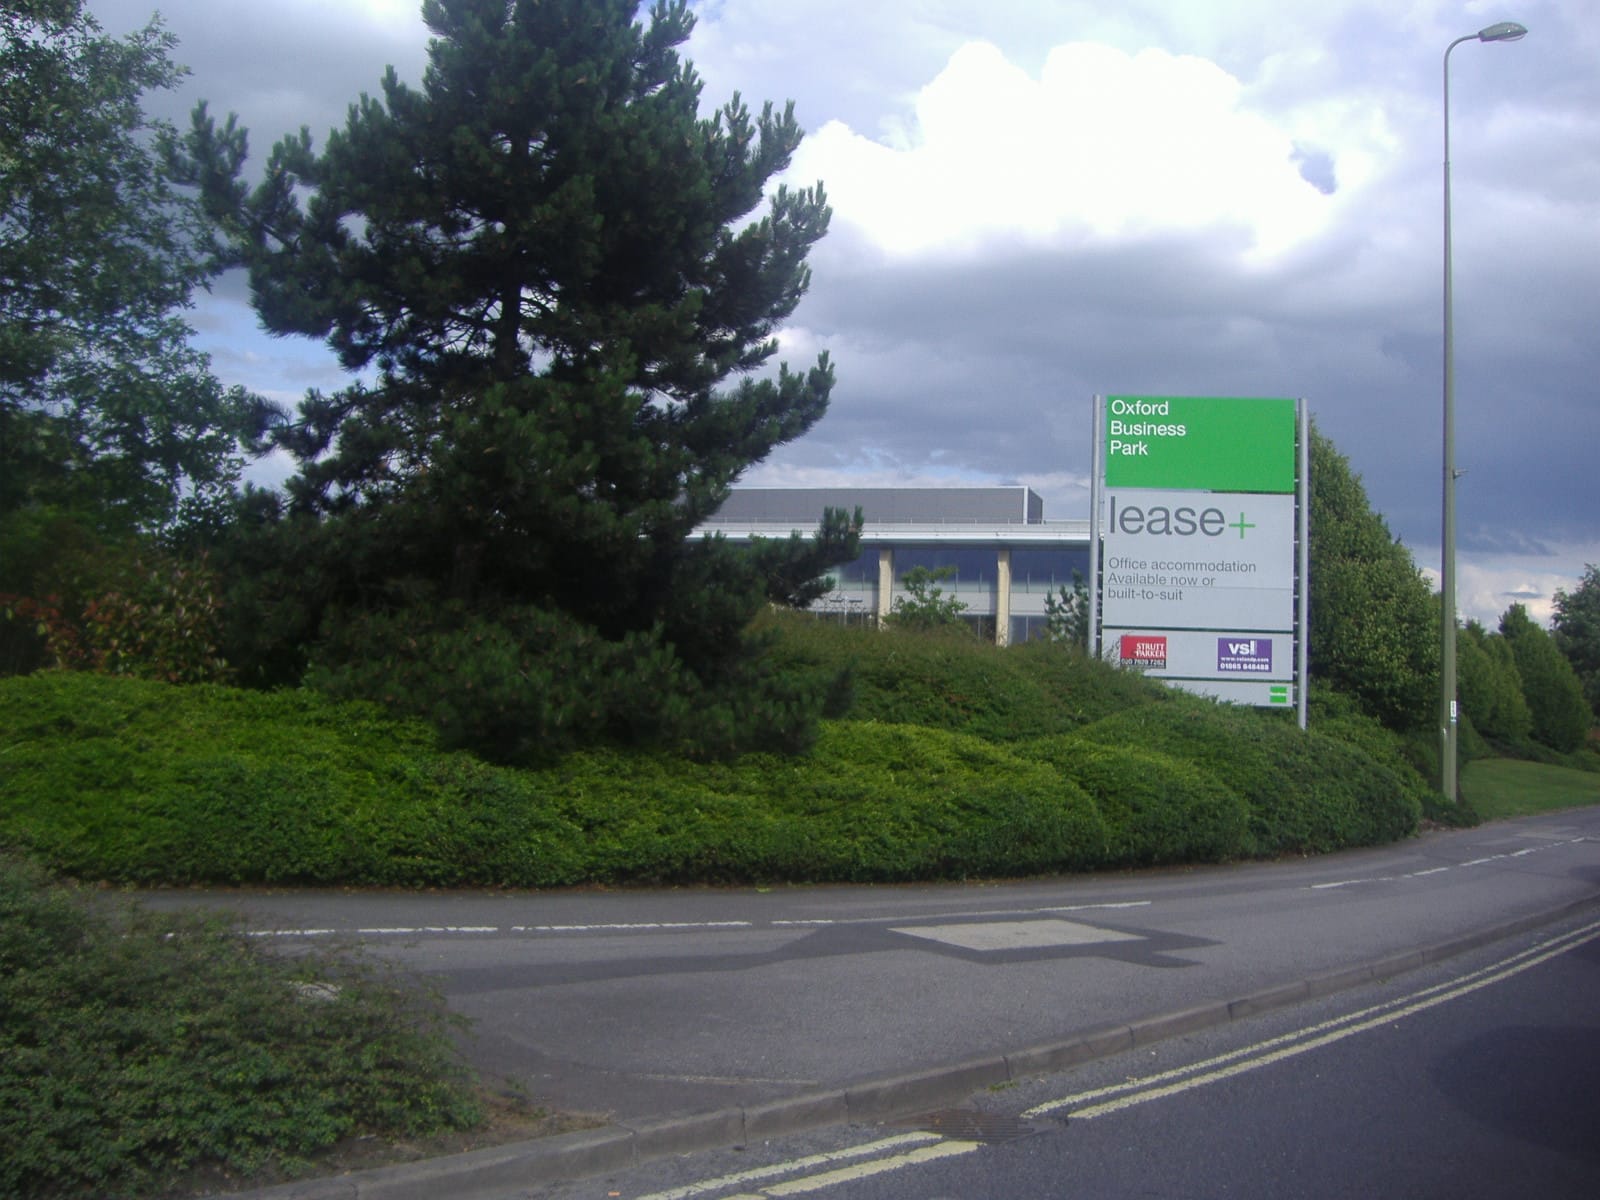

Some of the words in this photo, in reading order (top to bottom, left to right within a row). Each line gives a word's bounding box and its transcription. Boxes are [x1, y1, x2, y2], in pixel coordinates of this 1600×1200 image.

[1111, 399, 1169, 416] Oxford
[1110, 420, 1187, 437] Business
[1110, 440, 1148, 456] Park
[1108, 557, 1147, 570] Office
[1151, 558, 1257, 573] accommodation
[1107, 573, 1167, 585] Available
[1171, 576, 1198, 586] now
[1202, 576, 1216, 587] or
[1107, 587, 1184, 601] built-to-suit
[1136, 642, 1165, 650] STRUTT
[1228, 639, 1256, 656] vsl
